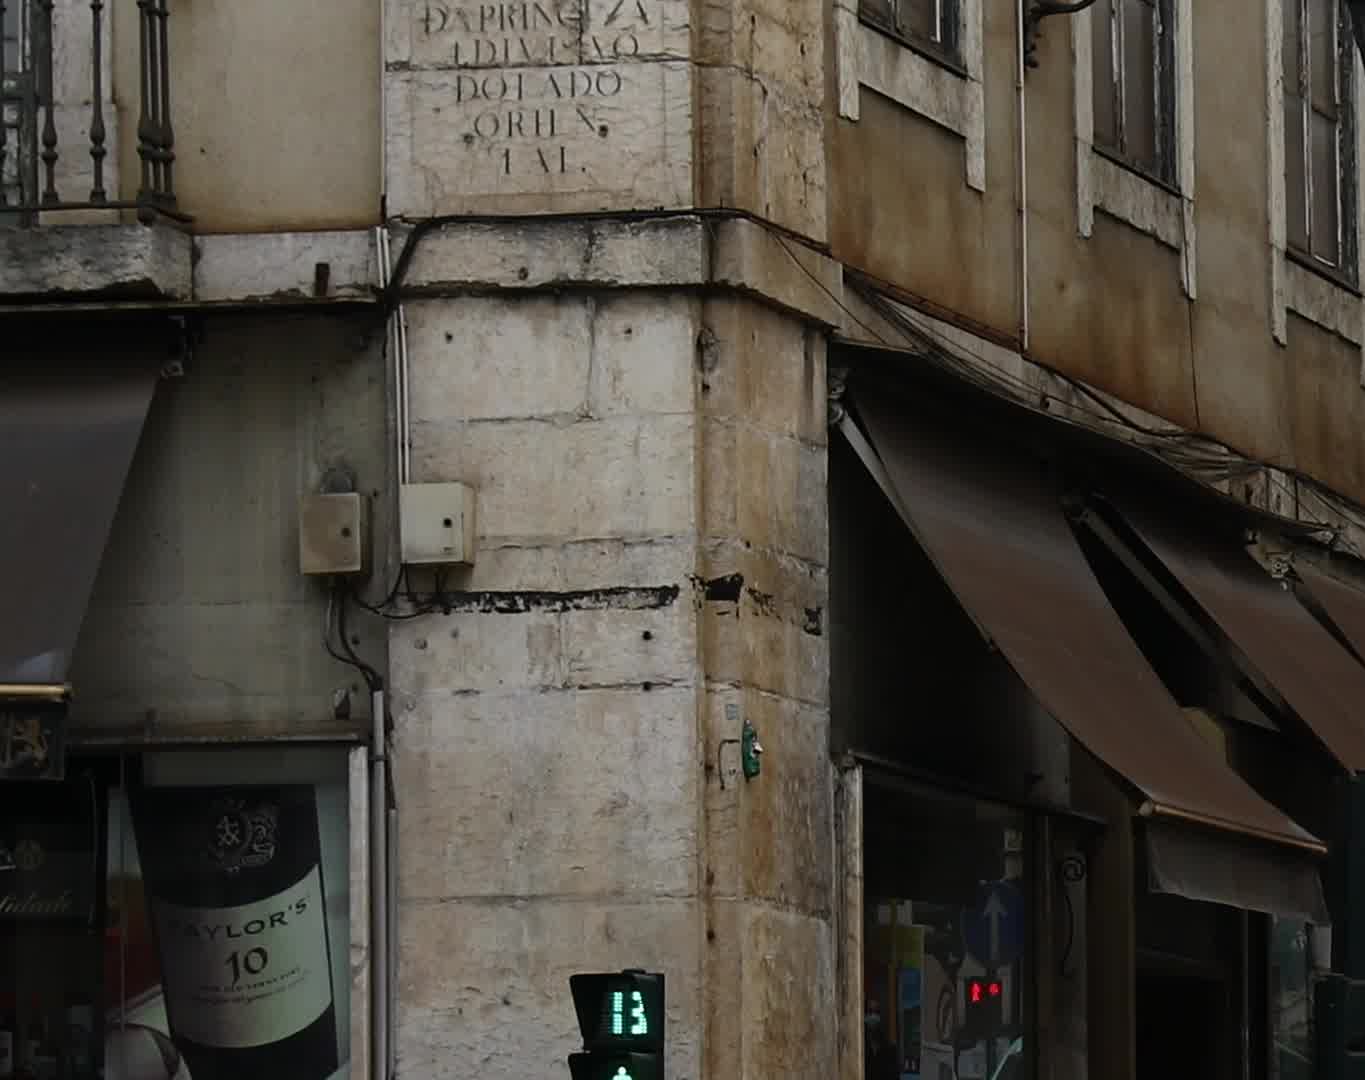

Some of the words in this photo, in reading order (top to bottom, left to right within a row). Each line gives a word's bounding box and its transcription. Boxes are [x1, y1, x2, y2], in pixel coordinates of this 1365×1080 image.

[170, 898, 307, 940] AYLOR'S
[223, 946, 269, 992] 10
[612, 990, 649, 1036] 13
